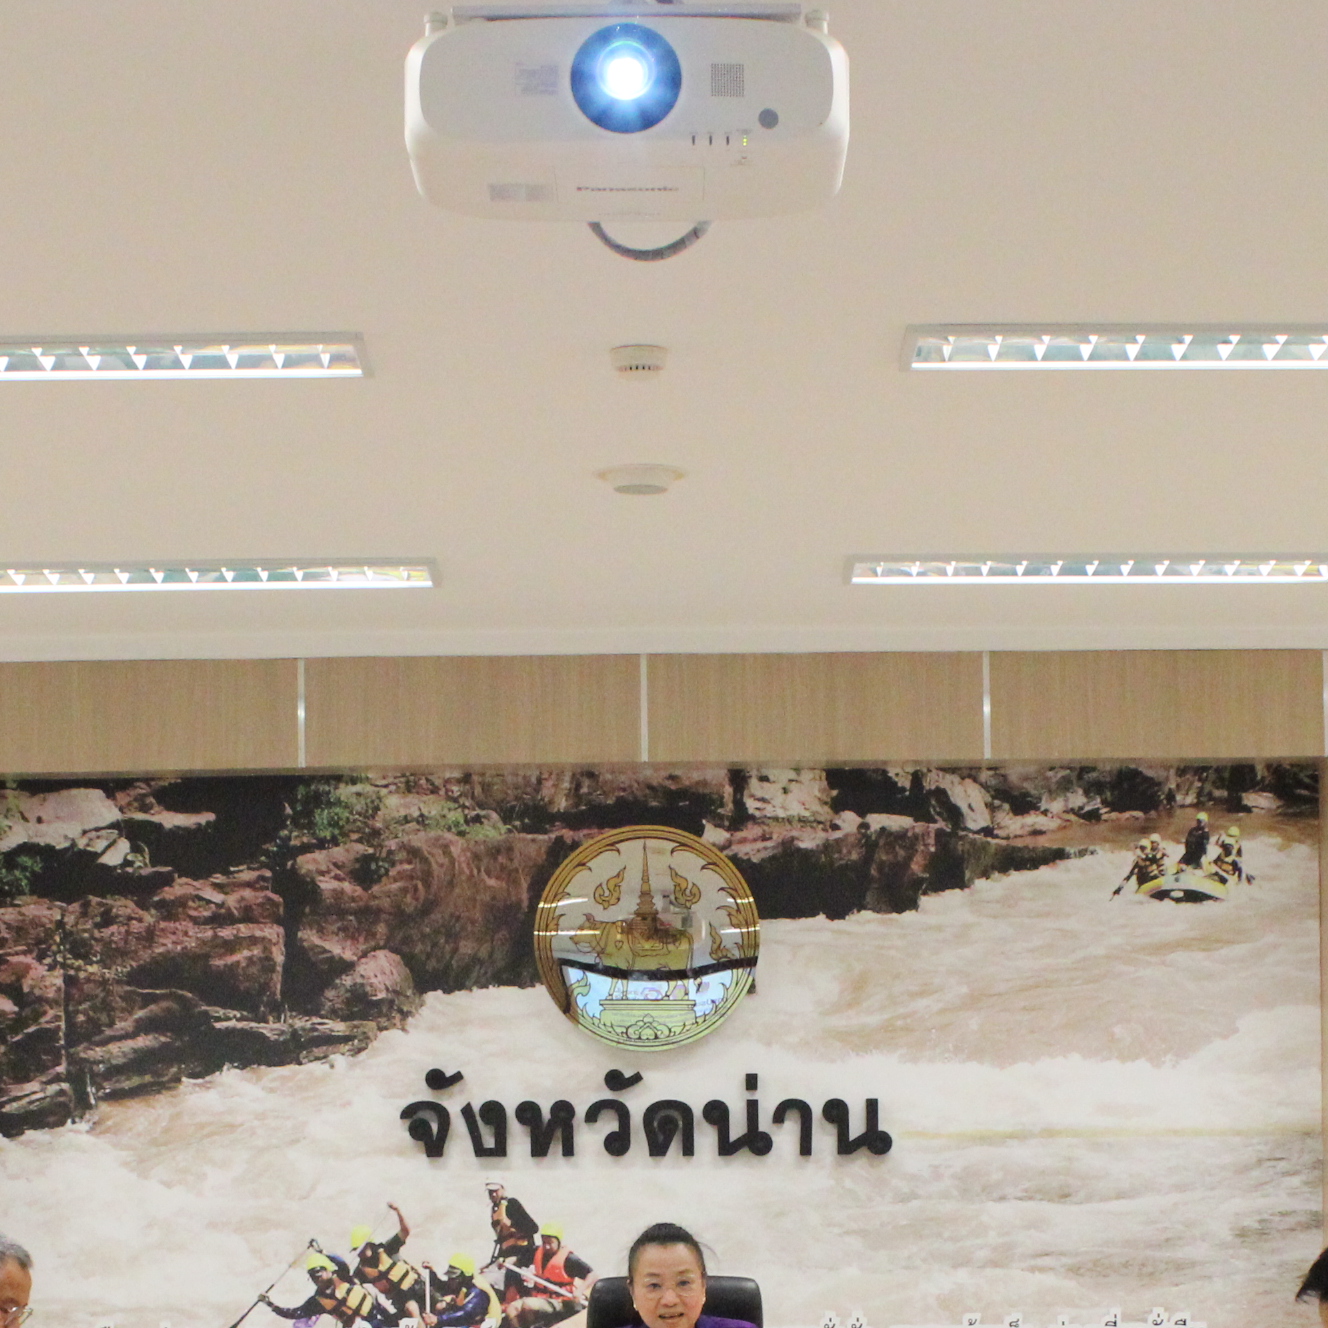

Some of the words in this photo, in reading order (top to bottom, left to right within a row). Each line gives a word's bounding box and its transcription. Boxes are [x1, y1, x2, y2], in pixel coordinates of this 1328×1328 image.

[399, 1067, 893, 1158] จังหวัดน่าน
